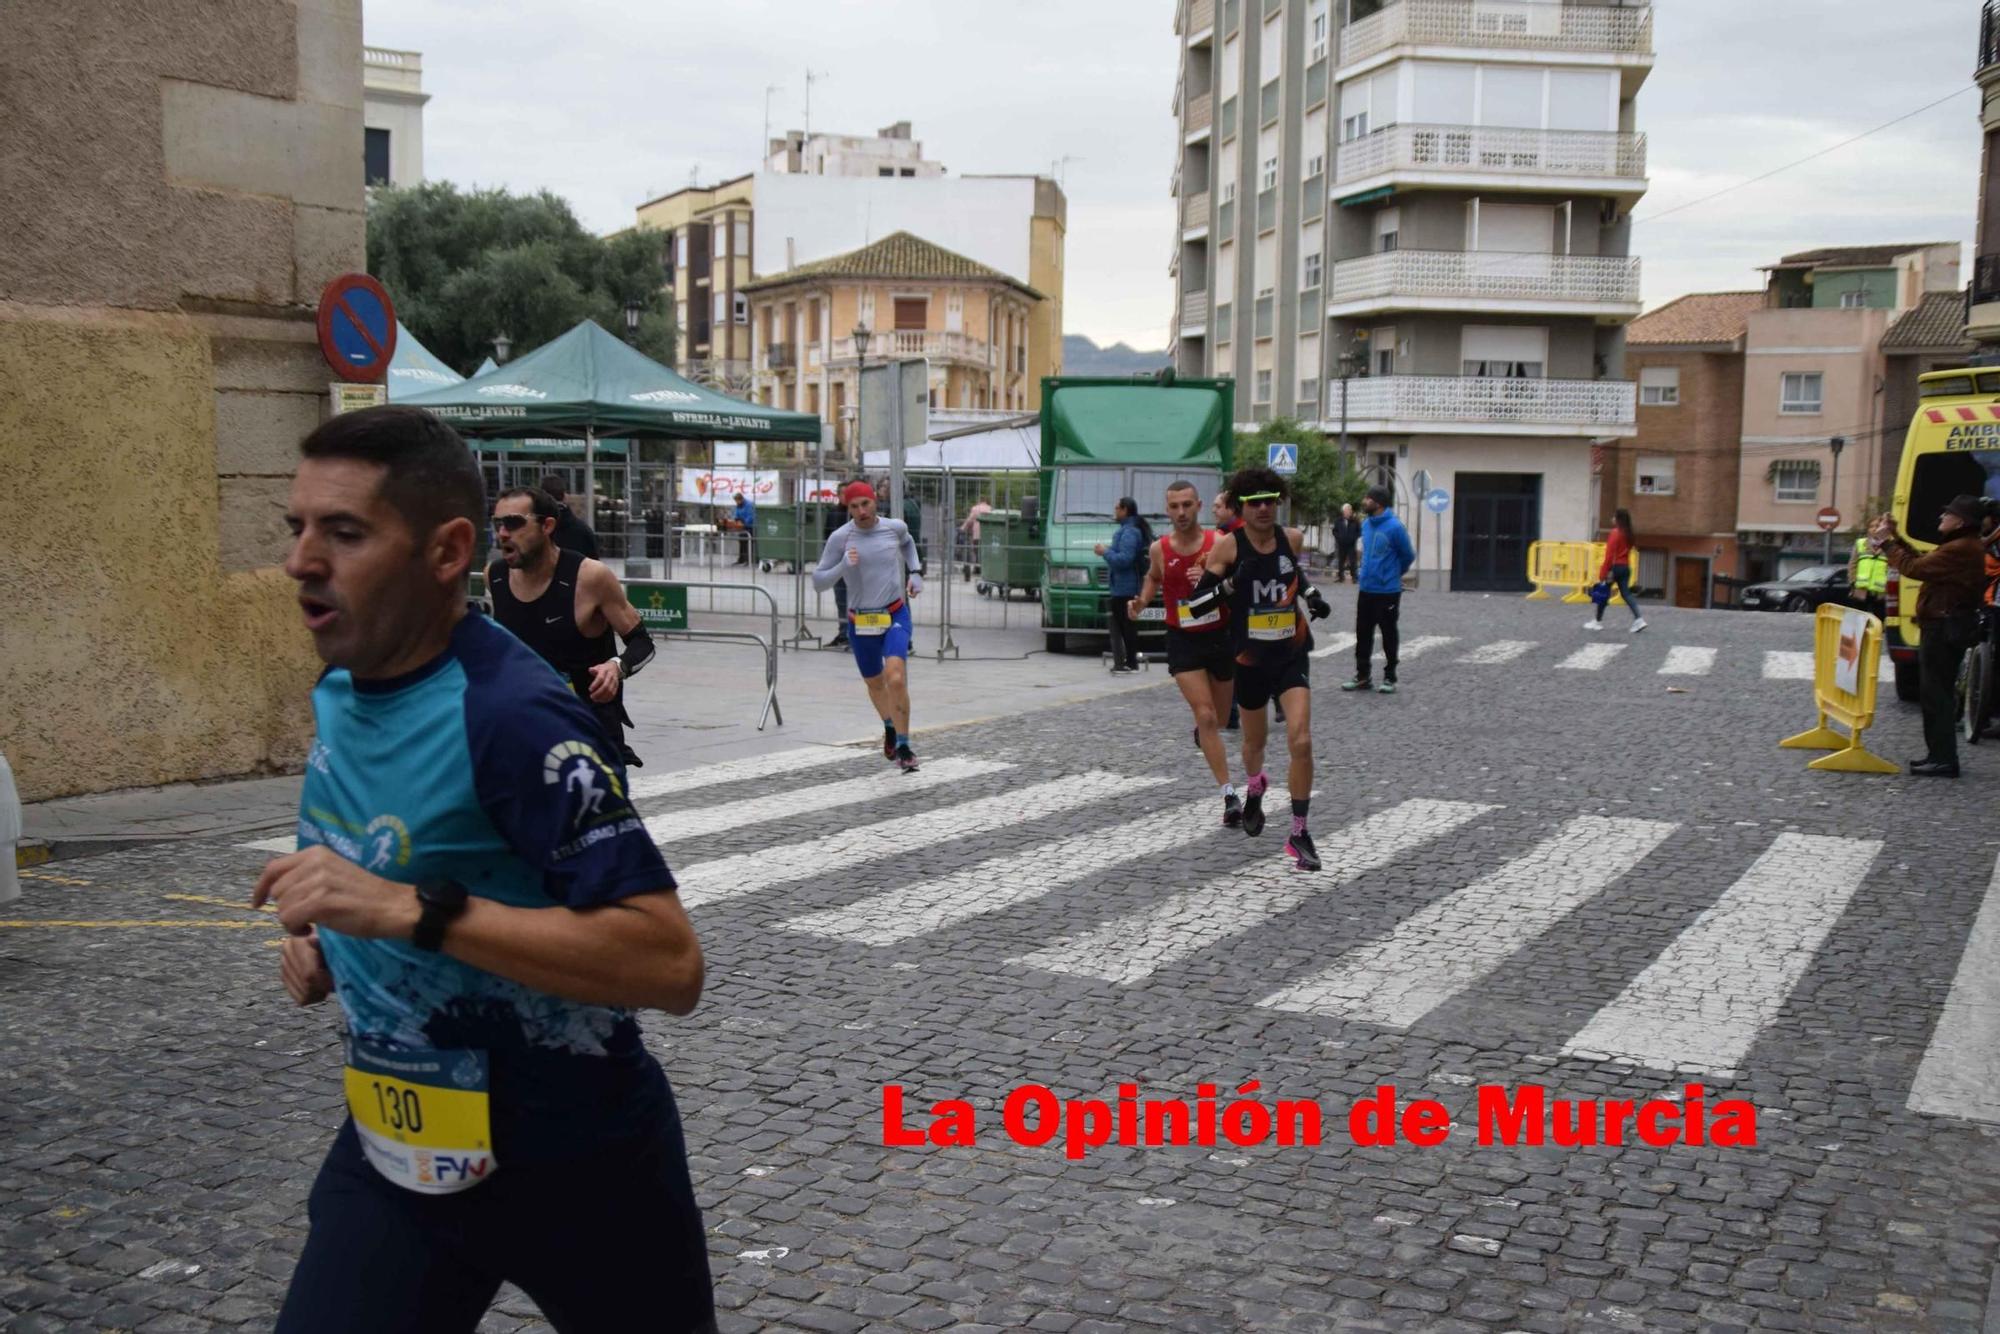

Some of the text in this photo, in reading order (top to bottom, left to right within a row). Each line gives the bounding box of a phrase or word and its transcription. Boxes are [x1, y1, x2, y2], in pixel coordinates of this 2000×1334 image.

[480, 407, 526, 417] LEVANTE
[672, 412, 721, 425] ESTRELLA
[729, 416, 770, 429] LEVANTE
[636, 608, 682, 618] STRELLA
[1267, 615, 1279, 626] 97
[371, 1081, 423, 1133] 130
